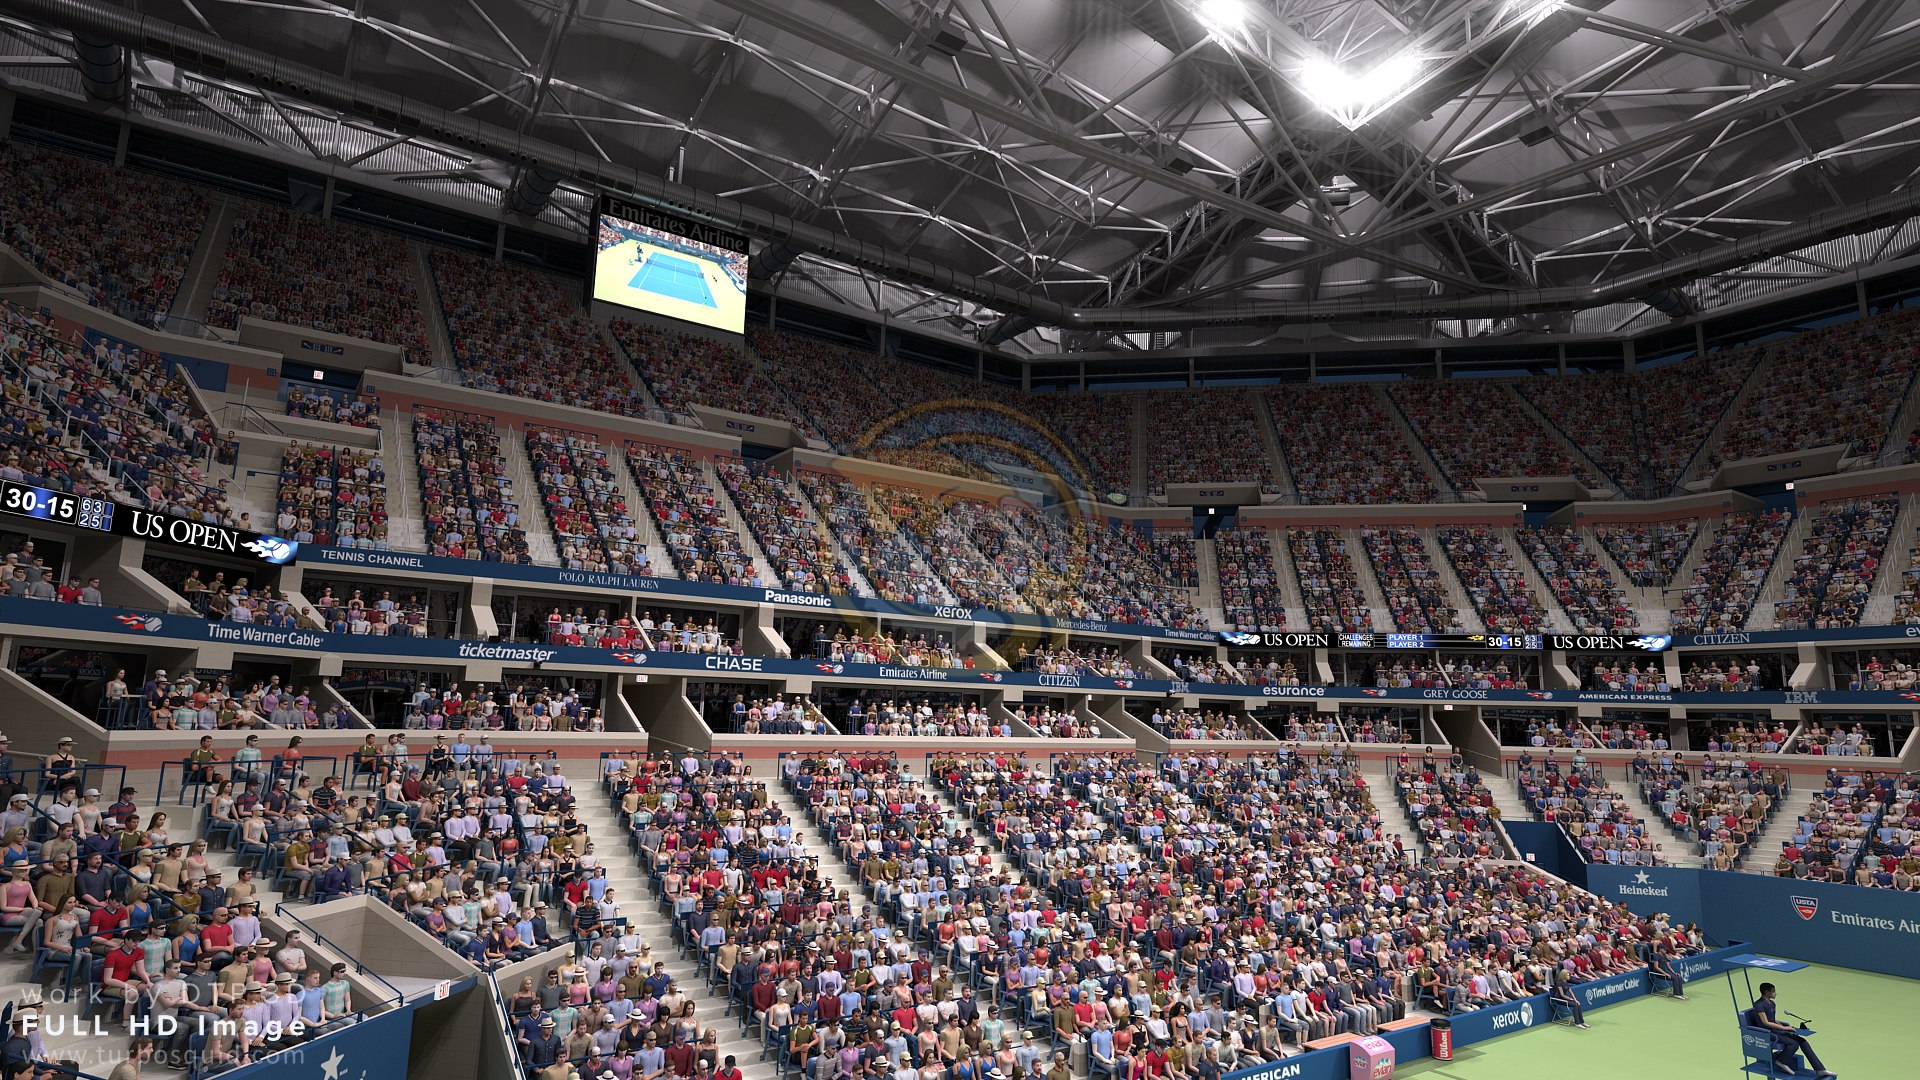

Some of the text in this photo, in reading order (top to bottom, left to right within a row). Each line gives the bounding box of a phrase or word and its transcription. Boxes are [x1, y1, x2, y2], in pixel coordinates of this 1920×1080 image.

[609, 199, 744, 251] Emirates Airline
[6, 488, 74, 518] 30-15
[132, 511, 239, 552] US OPEN
[321, 549, 424, 568] TENNIS CHANNEL
[559, 572, 659, 589] POLO RALPH LAUREN
[765, 590, 832, 607] Panasonic
[935, 606, 972, 620] xerox
[208, 623, 321, 647] Time Warner Cable
[1165, 629, 1180, 638] Time
[1180, 631, 1199, 640] Warner
[1264, 634, 1328, 647] US OPEN
[1488, 636, 1522, 647] 30-15
[1694, 633, 1750, 646] CITIZEN
[1552, 636, 1624, 649] US OPEN
[459, 642, 554, 662] ticketmaster
[705, 656, 763, 671] CHASE
[880, 666, 948, 680] Emirates Airline
[1038, 674, 1080, 687] CITIZEN
[1171, 681, 1190, 692] IBM
[1263, 686, 1325, 696] esurance
[1423, 689, 1488, 699] GREY GOOSE
[1784, 691, 1818, 704] IBM
[1618, 884, 1669, 897] Heineken
[1831, 910, 1895, 930] Emirates
[440, 982, 449, 998] EXIT
[1592, 987, 1606, 998] Time
[1605, 983, 1624, 995] Warner
[1492, 1010, 1520, 1030] xerox
[1440, 1032, 1448, 1058] Wilson
[1240, 1063, 1301, 1080] ERICAN
[1373, 1064, 1392, 1078] evian
